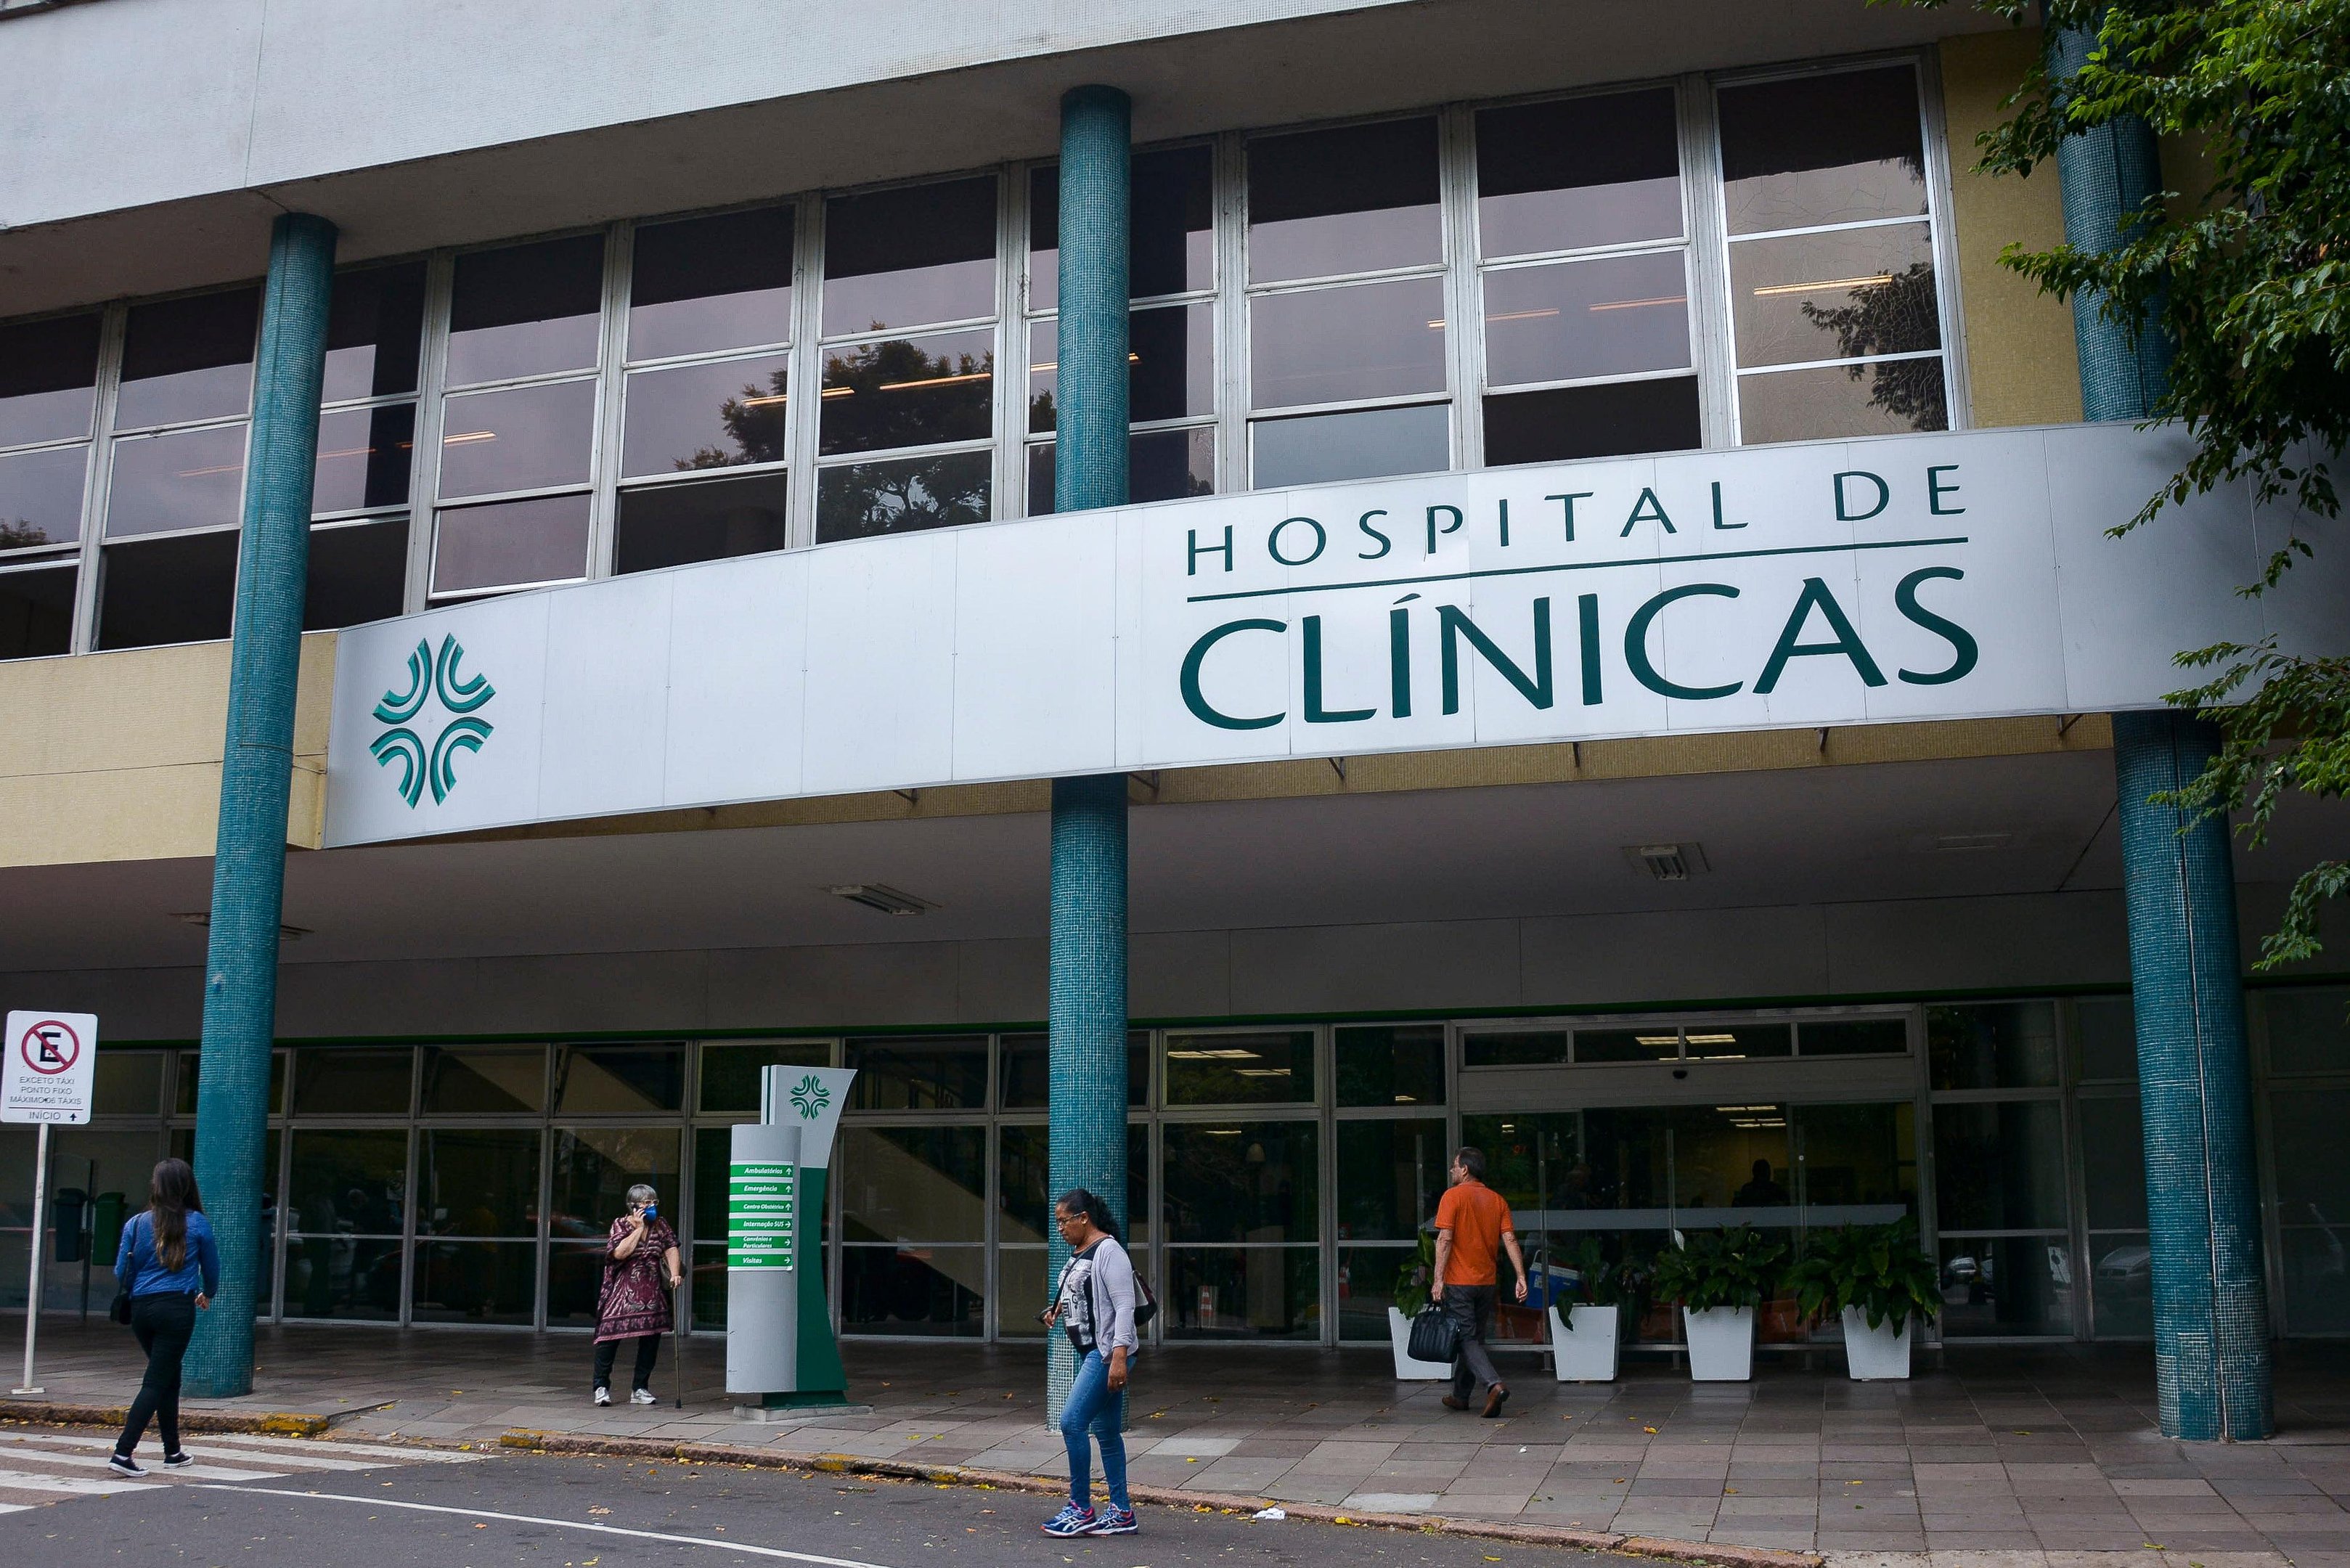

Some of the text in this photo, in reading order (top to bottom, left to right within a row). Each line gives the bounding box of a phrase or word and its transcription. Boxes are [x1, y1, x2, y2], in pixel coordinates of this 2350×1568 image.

[1186, 464, 1968, 576] HOSPITAL DE
[1179, 565, 1980, 730] CLÍNICAS
[19, 1076, 54, 1085] EXCETO
[29, 1110, 61, 1120] INÍCIO
[743, 1185, 778, 1193] Emergência
